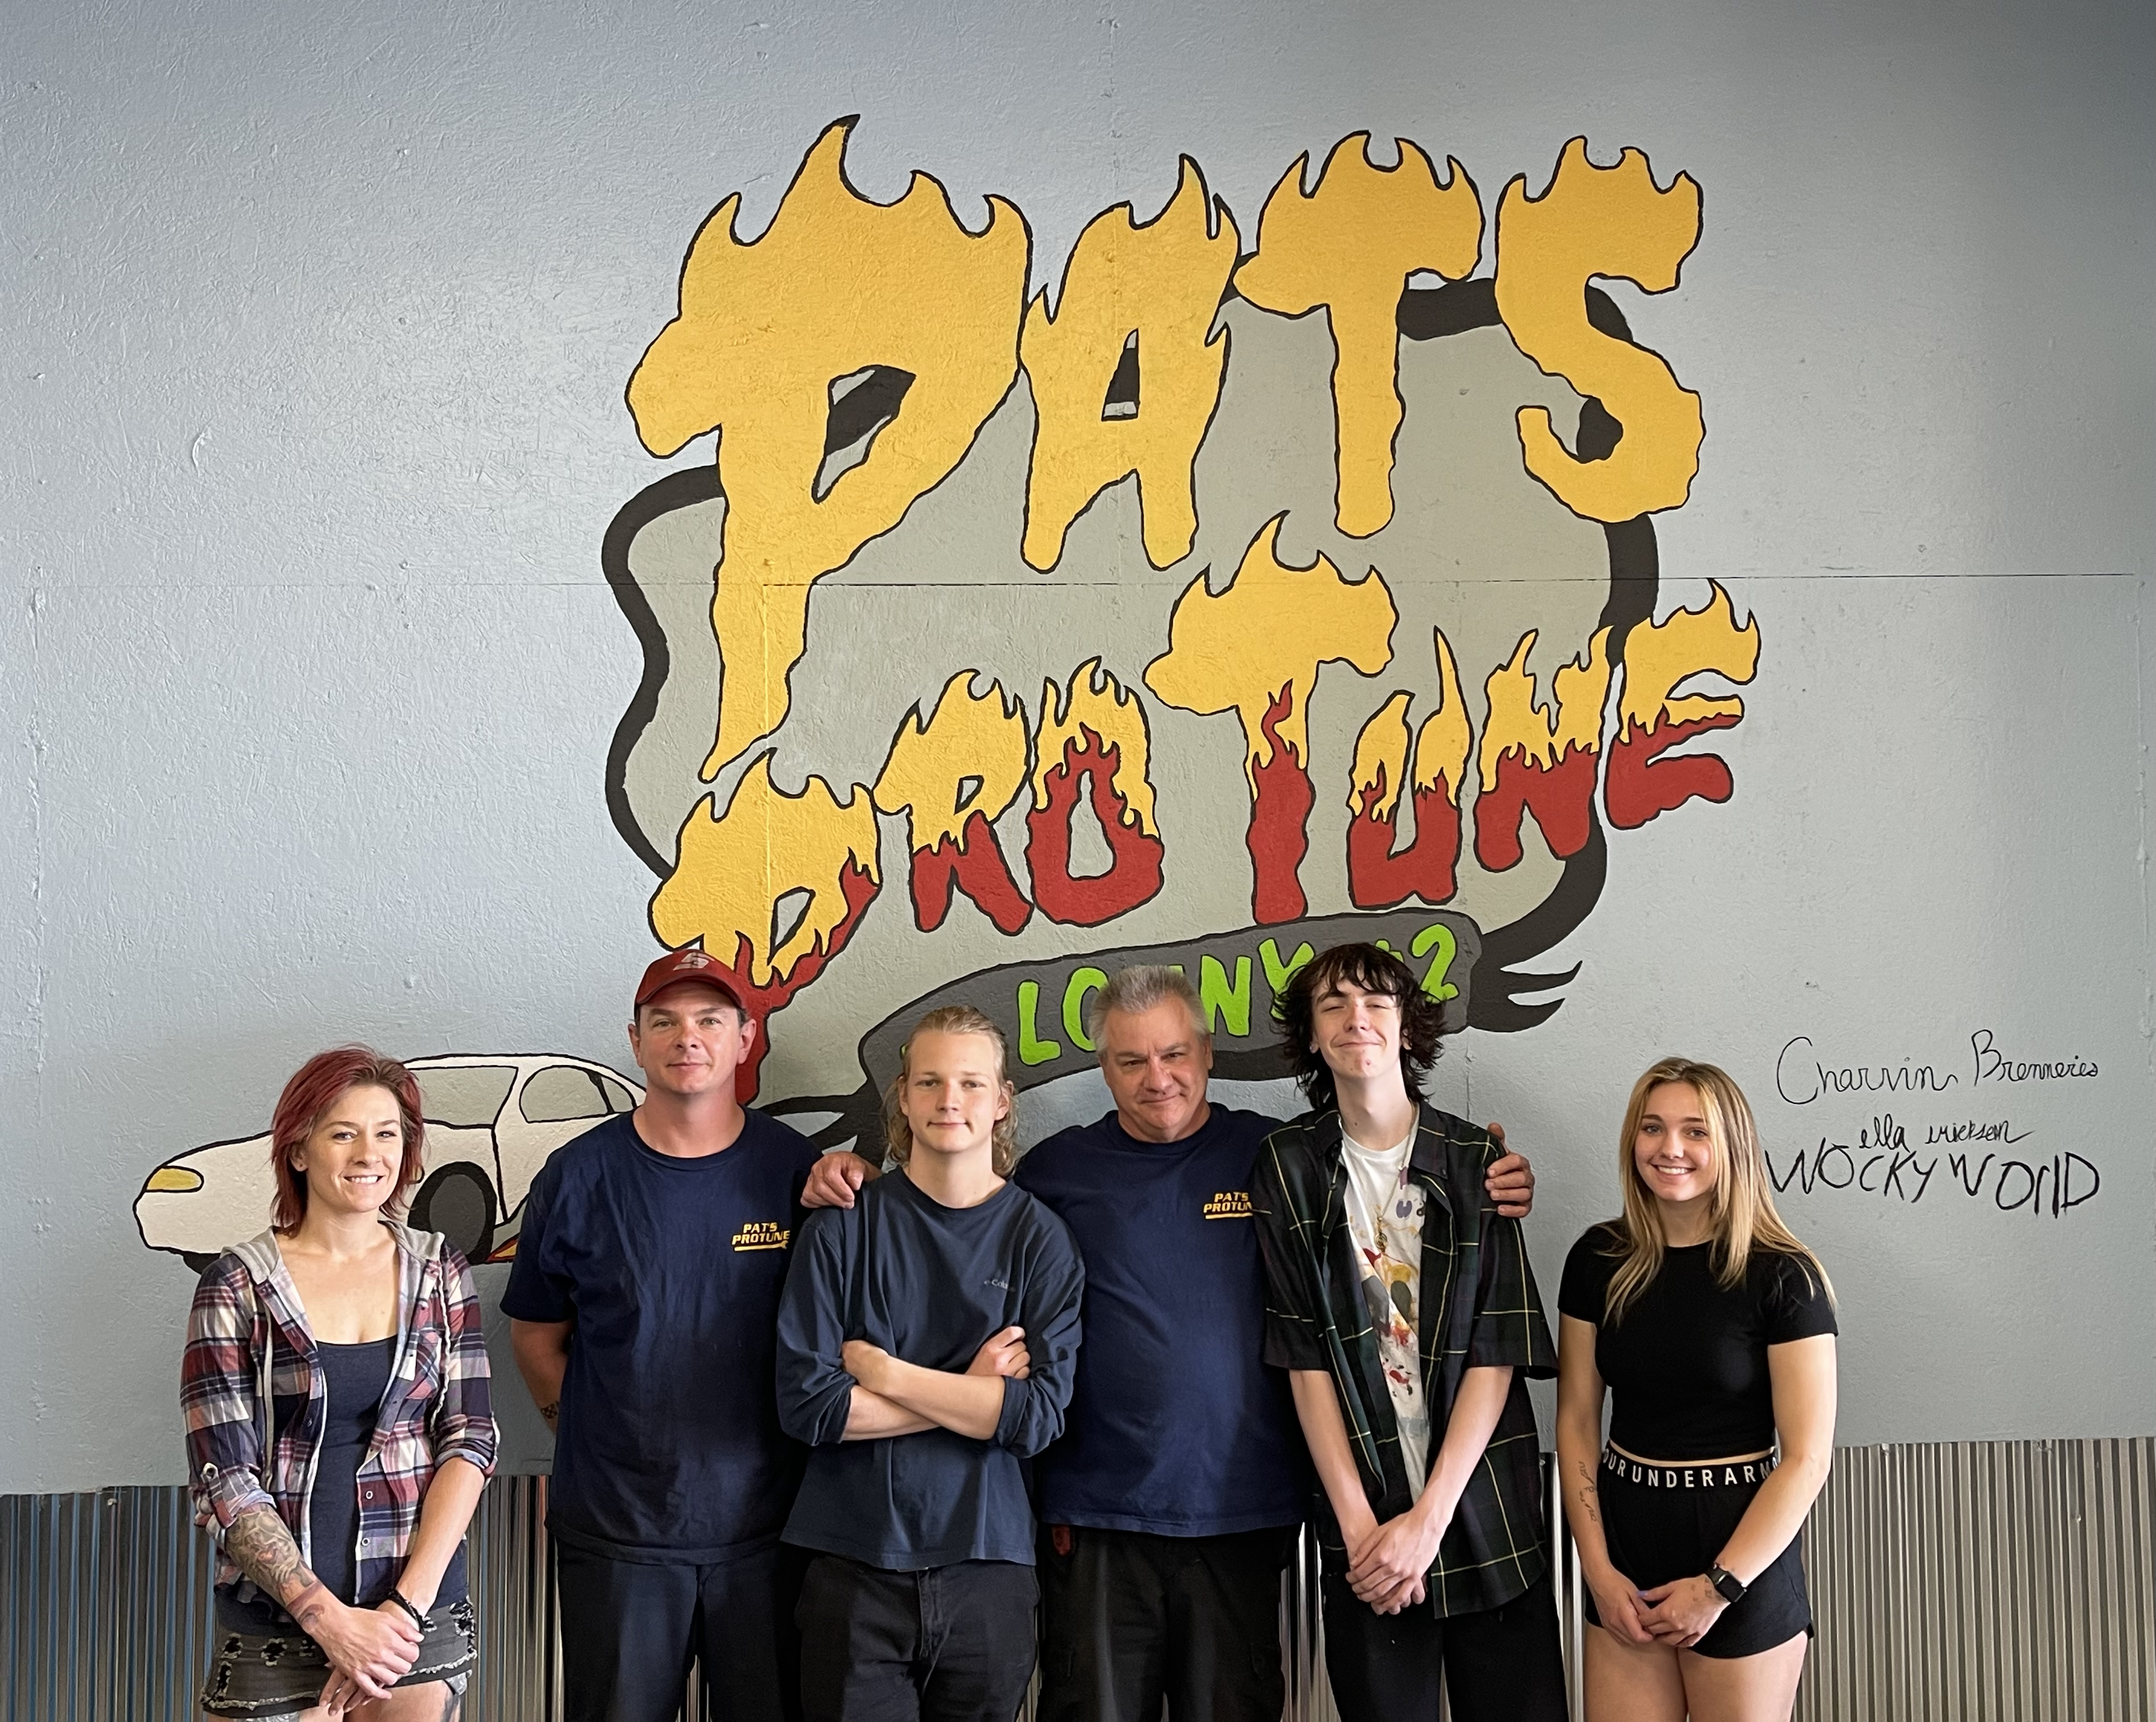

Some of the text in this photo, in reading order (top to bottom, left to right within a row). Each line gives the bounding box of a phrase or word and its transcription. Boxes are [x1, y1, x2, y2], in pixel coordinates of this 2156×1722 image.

[627, 115, 1705, 781] PATS
[732, 1231, 790, 1244] PROTUNE
[1632, 1465, 1714, 1487] UNDER
